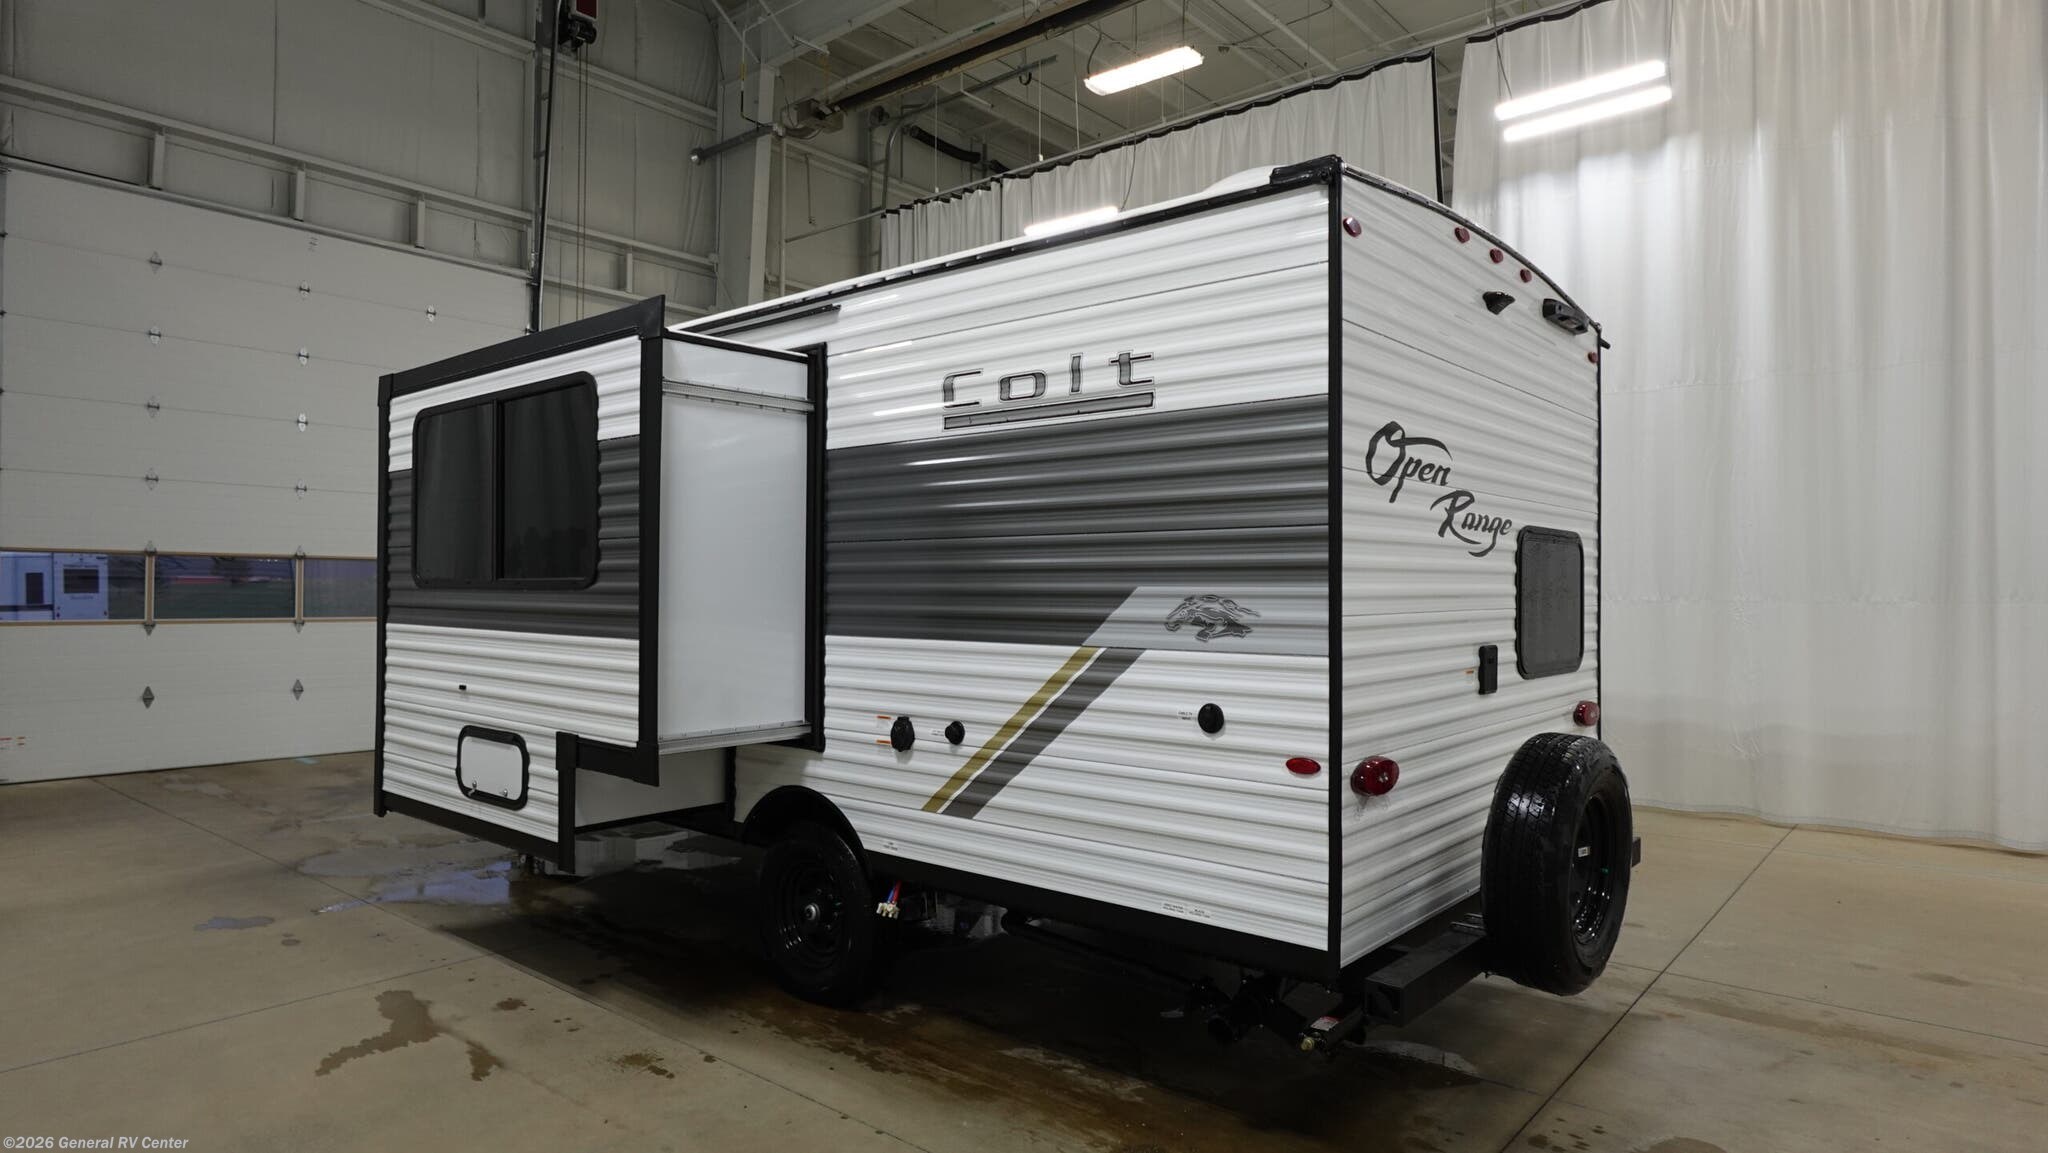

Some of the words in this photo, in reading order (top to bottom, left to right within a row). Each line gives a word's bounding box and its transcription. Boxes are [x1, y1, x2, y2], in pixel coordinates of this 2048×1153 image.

[942, 350, 1155, 409] Colt
[1365, 421, 1453, 503] Open
[1430, 489, 1513, 557] Range
